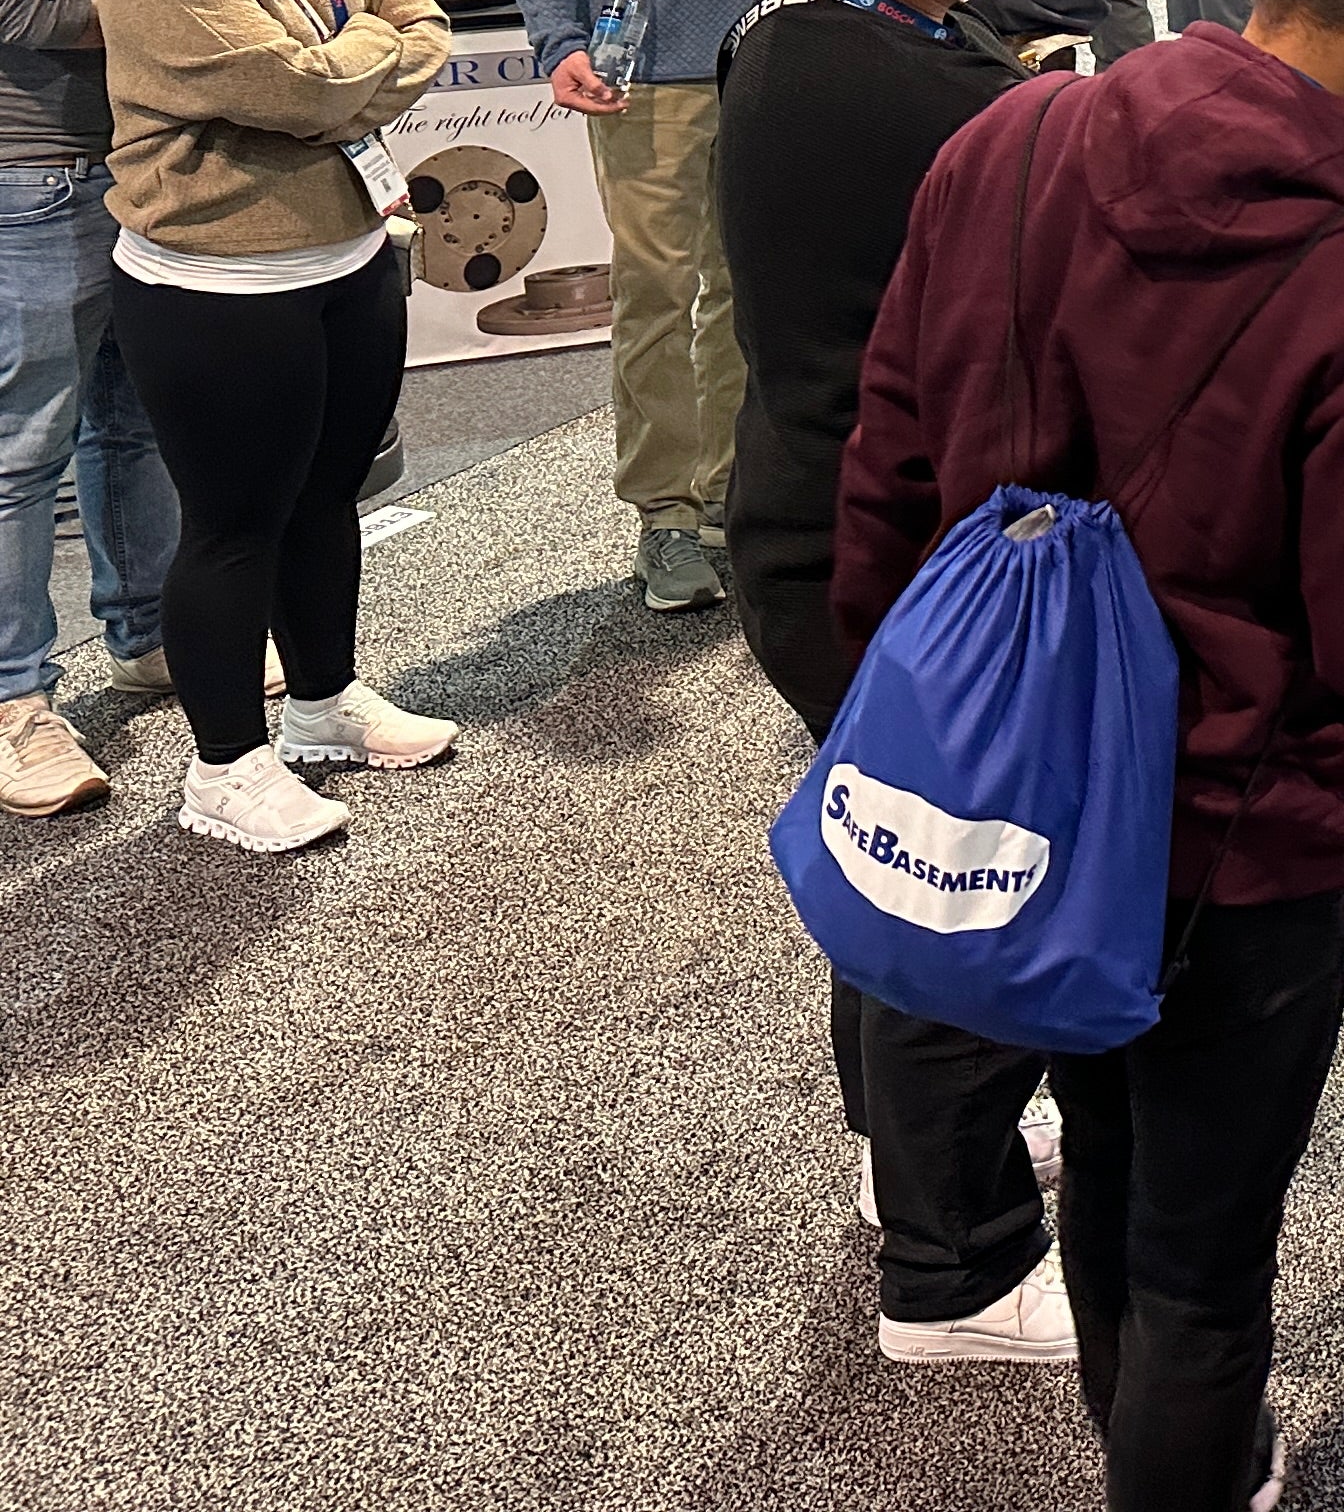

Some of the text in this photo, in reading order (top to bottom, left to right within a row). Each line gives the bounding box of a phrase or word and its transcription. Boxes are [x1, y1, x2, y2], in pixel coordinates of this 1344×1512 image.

[877, 2, 916, 26] BOSCH
[385, 105, 429, 136] The
[435, 105, 491, 142] right
[497, 100, 544, 132] tool
